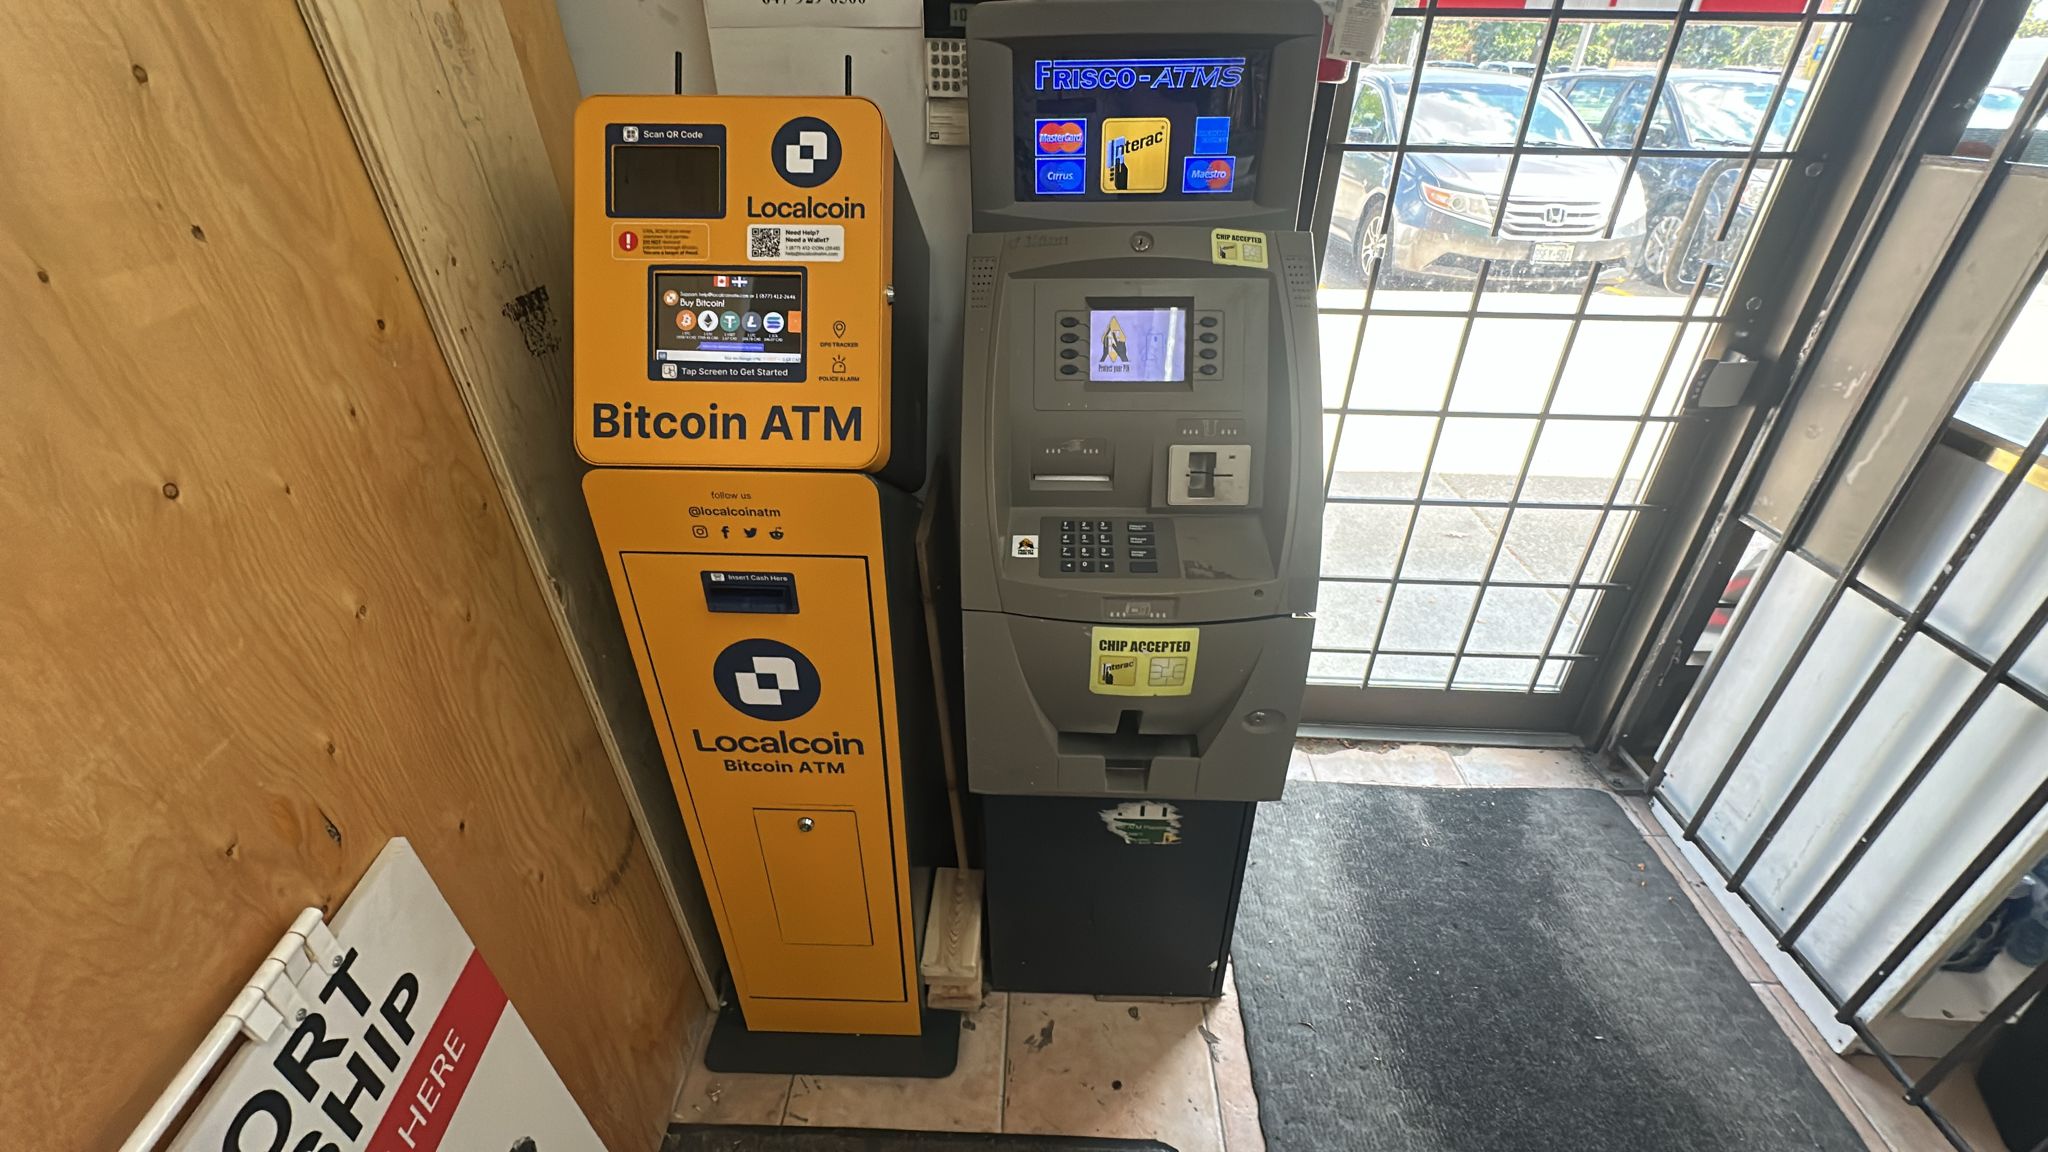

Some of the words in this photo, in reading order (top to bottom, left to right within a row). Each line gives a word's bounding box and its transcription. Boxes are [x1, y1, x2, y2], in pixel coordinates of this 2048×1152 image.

[643, 130, 665, 139] Scan
[666, 130, 679, 139] QR
[680, 130, 703, 139] Code
[1039, 133, 1083, 143] MasterCard
[1108, 131, 1163, 170] Interac
[1047, 171, 1074, 181] Cirrus
[1191, 169, 1227, 179] Maestro
[747, 195, 865, 219] Localcoin
[802, 229, 820, 237] Help?
[1215, 233, 1231, 241] CHIP
[1231, 234, 1262, 244] ACCEPTED
[680, 299, 694, 308] Buy
[695, 298, 725, 308] Bitcoin!
[681, 367, 697, 377] Tap
[698, 368, 728, 377] Screen
[729, 368, 739, 377] to
[740, 368, 755, 377] Get
[757, 368, 789, 377] Started
[593, 401, 747, 440] Bitcoin
[760, 405, 862, 442] ATM
[711, 490, 738, 500] follow
[740, 492, 752, 500] us
[688, 506, 781, 518] @localcoinatm
[750, 574, 769, 582] Cash
[1099, 639, 1128, 652] CHIP
[1129, 640, 1191, 653] ACCEPTED
[692, 729, 865, 756] Localcoin
[723, 759, 793, 773] Bitcoin
[799, 760, 845, 774] ATM
[292, 972, 419, 1152] HIP
[397, 1027, 467, 1149] HERE
